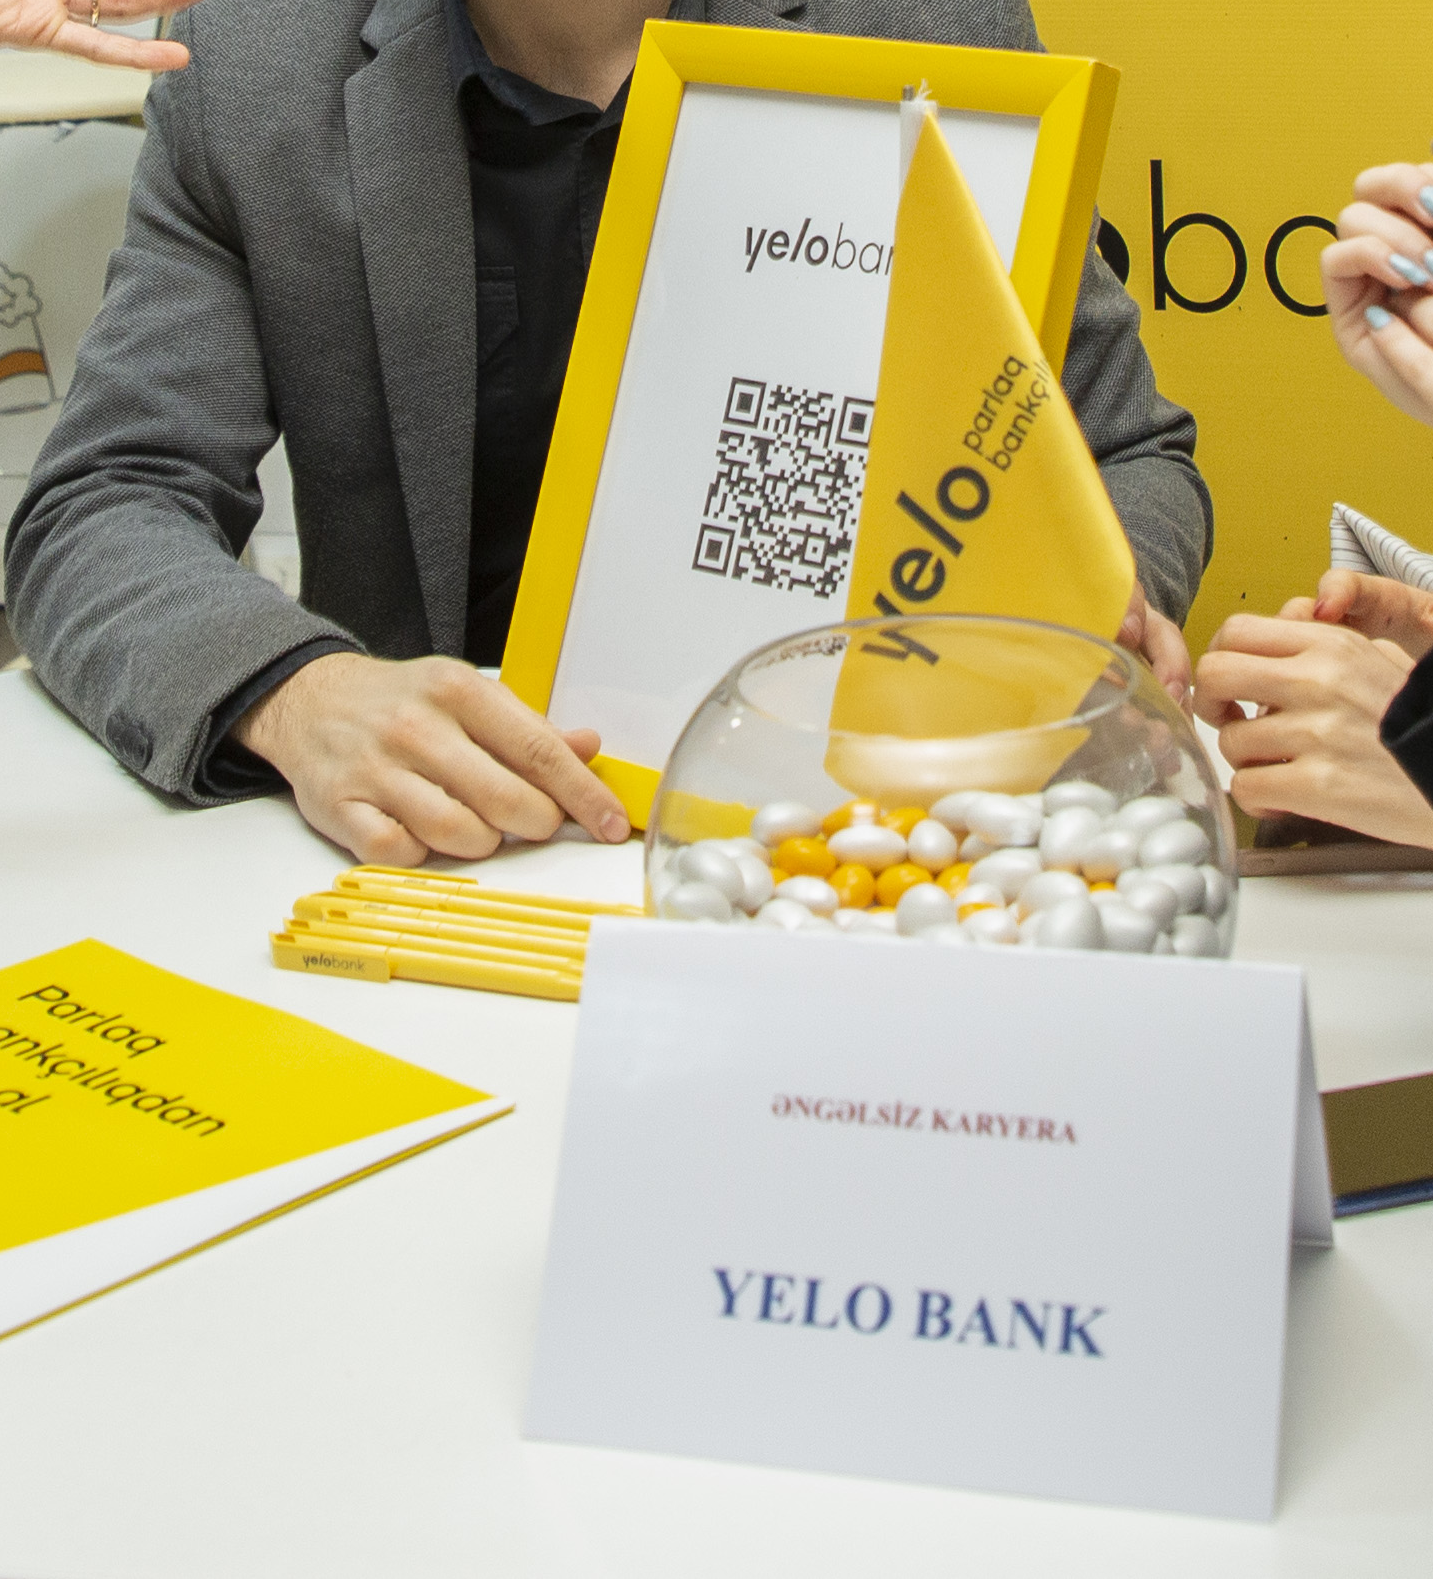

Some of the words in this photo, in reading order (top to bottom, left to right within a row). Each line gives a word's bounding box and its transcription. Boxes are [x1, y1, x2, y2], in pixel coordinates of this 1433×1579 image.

[962, 355, 1029, 458] parlaq
[860, 465, 991, 666] yelo
[302, 953, 366, 971] yelobank
[17, 984, 167, 1059] Parlaq
[771, 1092, 922, 1131] ƏNGƏLSİZ
[930, 1107, 1077, 1144] KARYERA
[713, 1267, 893, 1335] YELO
[913, 1287, 1108, 1359] BANK
